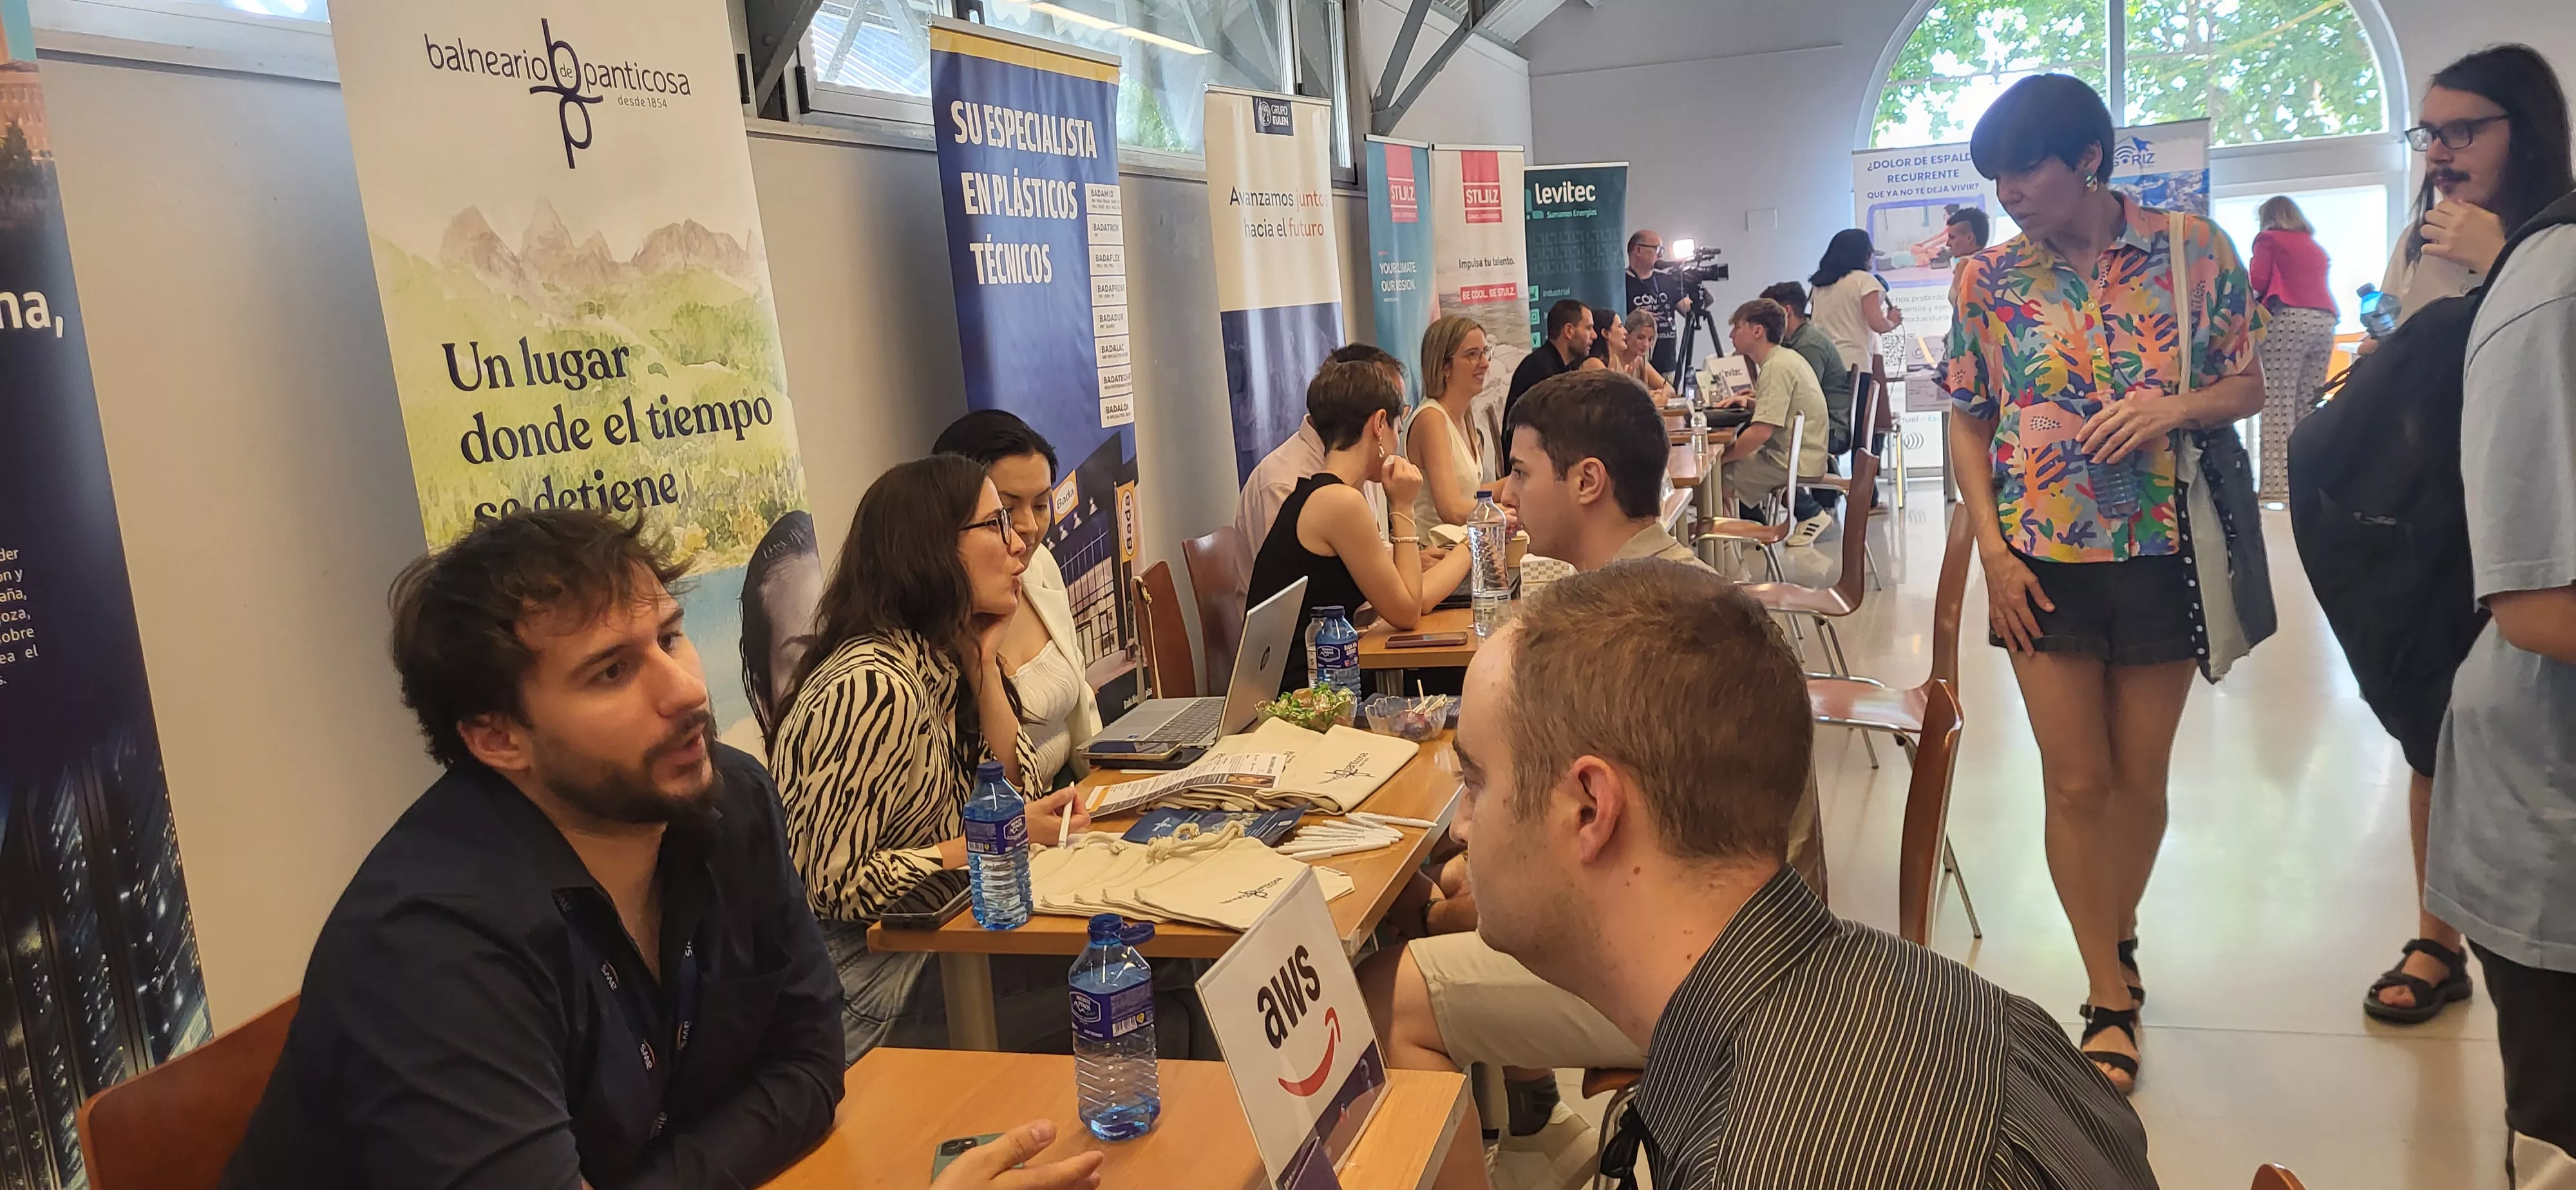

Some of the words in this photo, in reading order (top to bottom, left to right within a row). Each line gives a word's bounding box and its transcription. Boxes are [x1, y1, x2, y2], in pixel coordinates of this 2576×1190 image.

[424, 33, 548, 82] balneario
[559, 63, 573, 79] de
[583, 61, 691, 96] panticosa
[618, 95, 645, 108] desde
[647, 97, 667, 109] 1854
[951, 100, 983, 145] SU
[983, 104, 1097, 158] ESPECIALISTA
[1867, 157, 1911, 171] ¿DOLOR
[1914, 156, 1928, 165] DE
[1931, 153, 1971, 164] ESPALD
[1888, 168, 1959, 184] RECURRENTE
[960, 172, 992, 216] EN
[992, 167, 1079, 220] PLÁSTICOS
[1229, 185, 1294, 206] Avanzamos
[1295, 189, 1329, 213] juntos
[1466, 189, 1499, 204] STULZ
[1535, 180, 1596, 204] levitec
[1867, 190, 1885, 199] QUE
[1927, 185, 1949, 194] DEJA
[1244, 218, 1274, 238] hacia
[1276, 218, 1287, 238] el
[1288, 218, 1324, 238] futuro
[970, 234, 1052, 285] TÉCNICOS
[1459, 258, 1483, 270] Impulsa
[1484, 257, 1492, 267] tu
[1462, 290, 1472, 300] BE
[442, 341, 516, 392] Un
[518, 335, 630, 391] lugar
[460, 403, 593, 465] donde
[604, 396, 639, 446] el
[645, 394, 772, 441] tiempo
[533, 469, 678, 513] detiene
[1056, 486, 1075, 510] Bada
[1124, 493, 1133, 550] Bada
[14, 569, 23, 583] y
[25, 644, 39, 659] el
[601, 963, 617, 991] aws
[1256, 944, 1321, 1050] aws
[639, 1043, 653, 1071] aws
